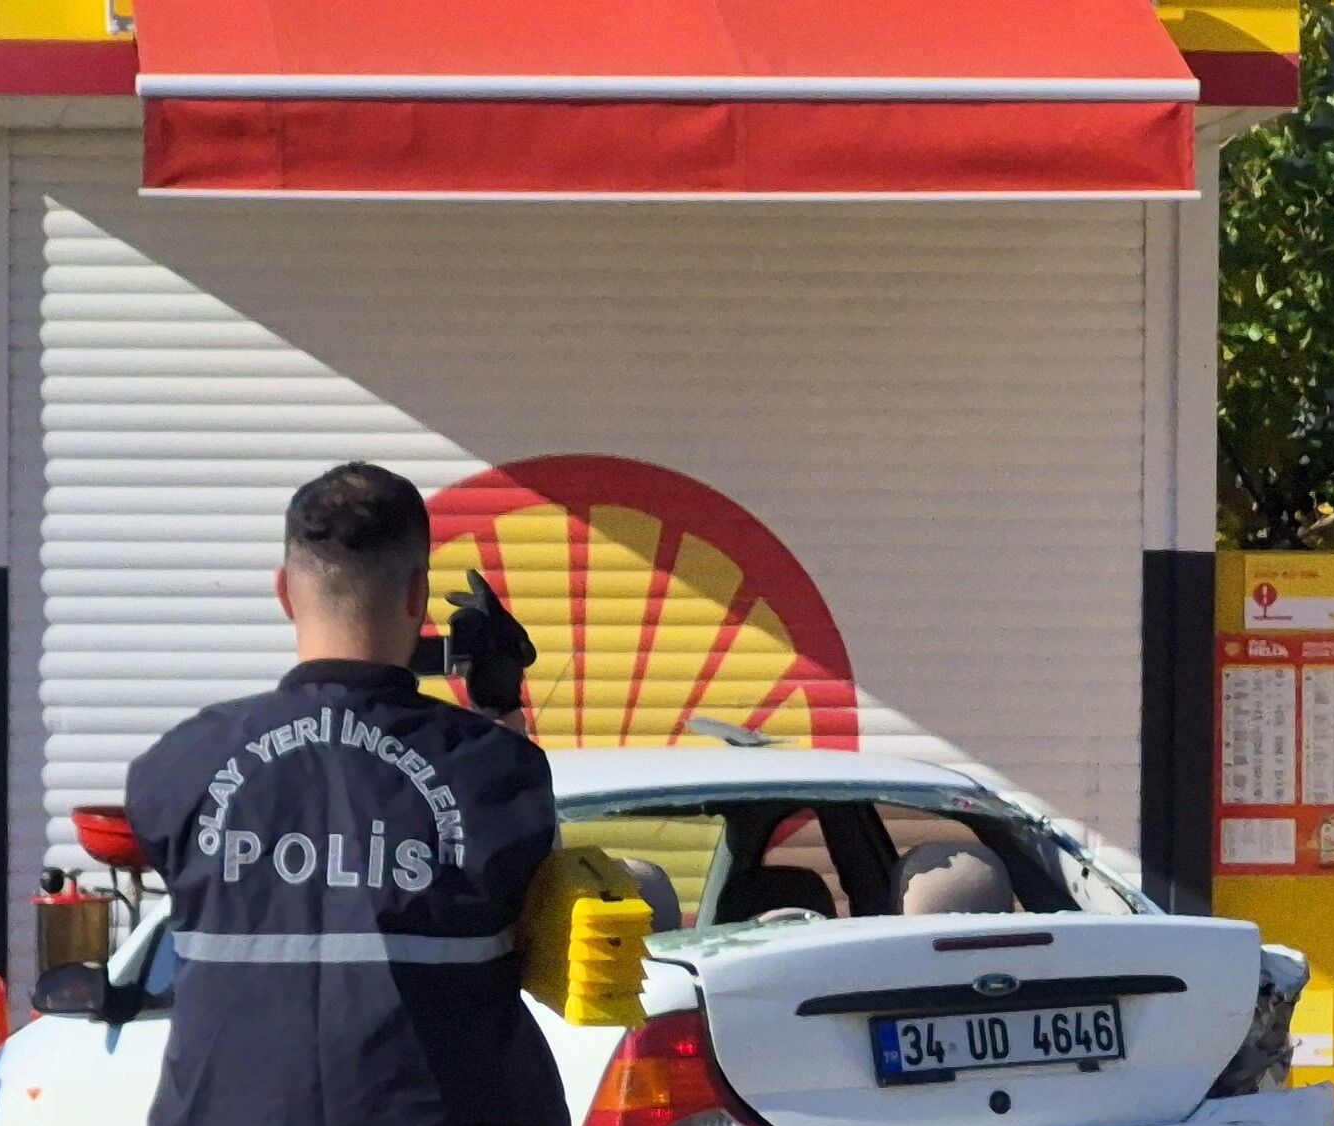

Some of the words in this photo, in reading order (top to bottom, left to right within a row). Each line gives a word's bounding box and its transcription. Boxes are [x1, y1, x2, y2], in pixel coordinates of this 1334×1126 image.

[198, 757, 245, 856] OLAY
[245, 707, 332, 763] YERİ
[340, 708, 465, 868] İNCELEME
[224, 819, 433, 891] POLİS
[901, 1022, 945, 1066] 34
[967, 1017, 1010, 1060] UD
[1033, 1010, 1114, 1056] 4646
